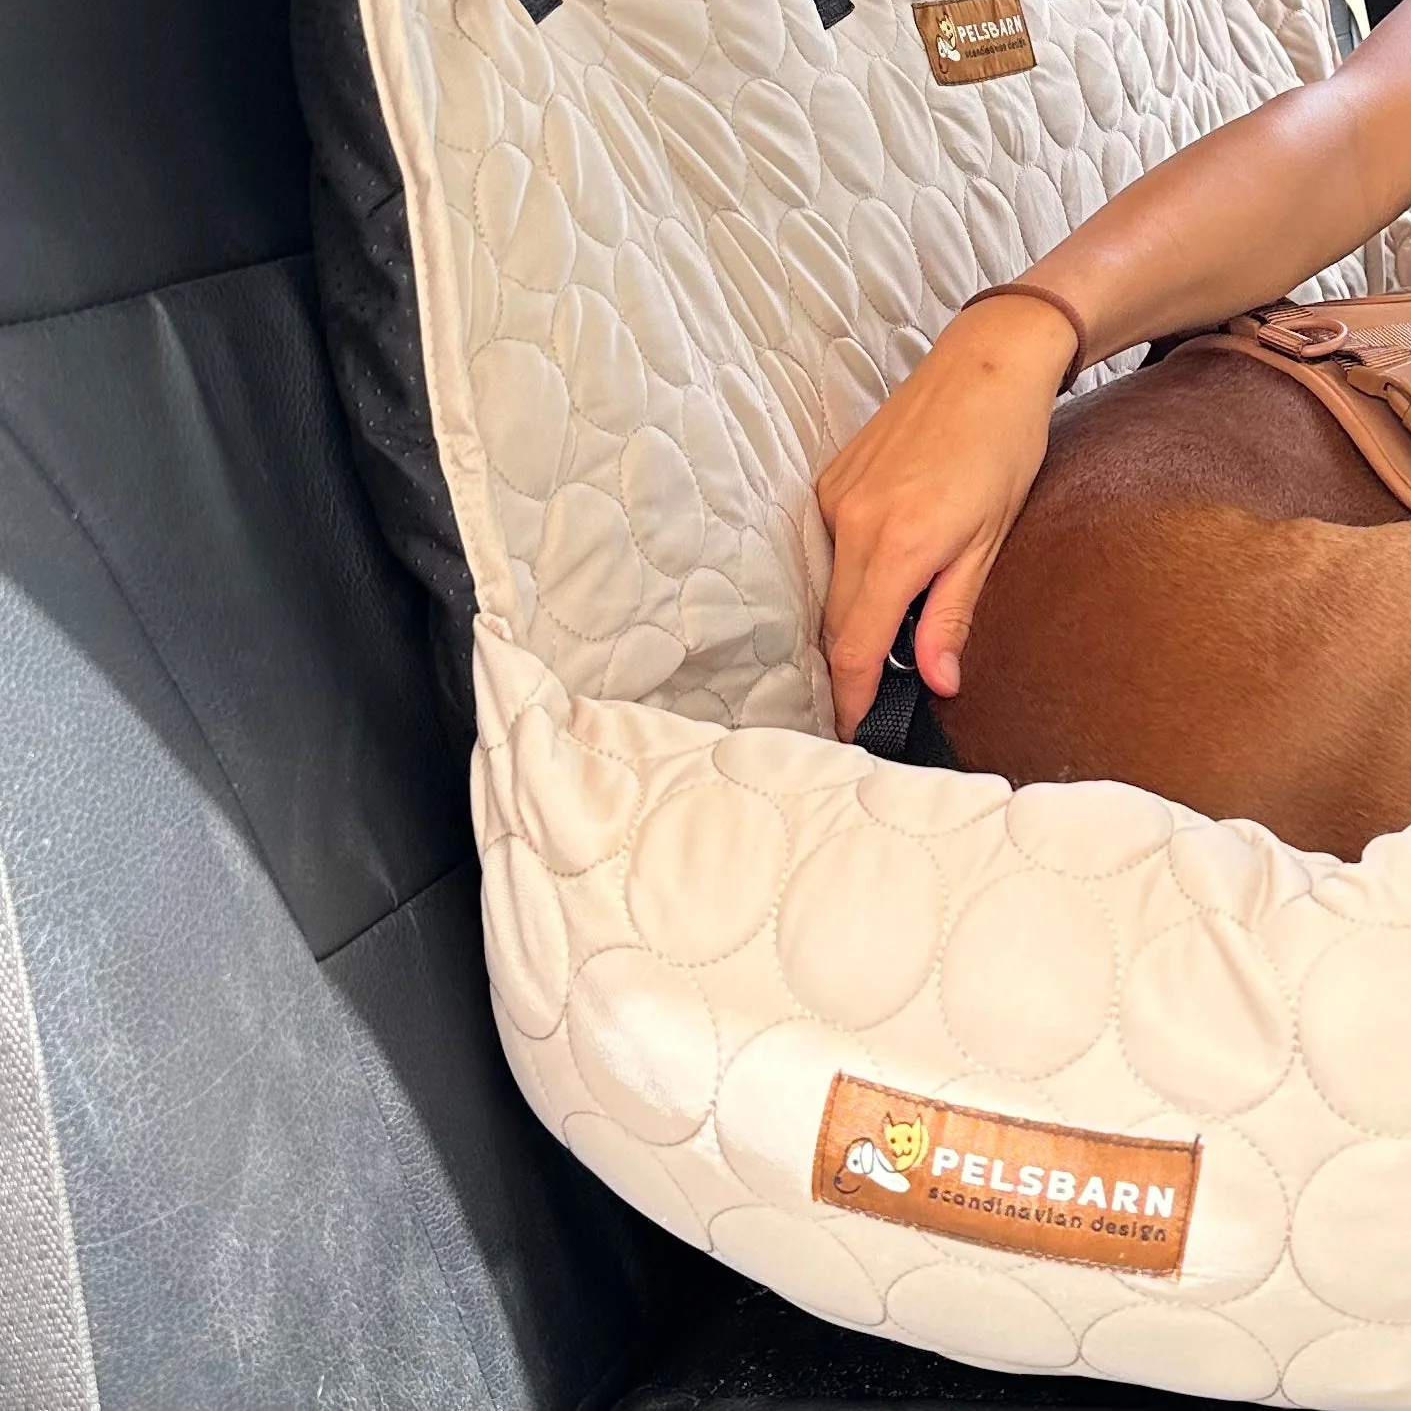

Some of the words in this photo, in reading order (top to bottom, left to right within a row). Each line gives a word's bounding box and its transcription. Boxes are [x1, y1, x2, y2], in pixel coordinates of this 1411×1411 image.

[956, 14, 1024, 44] PELSBARN
[931, 1146, 1175, 1219] PELSBARN
[928, 1184, 1082, 1230] scandinavian
[1090, 1216, 1168, 1243] design
